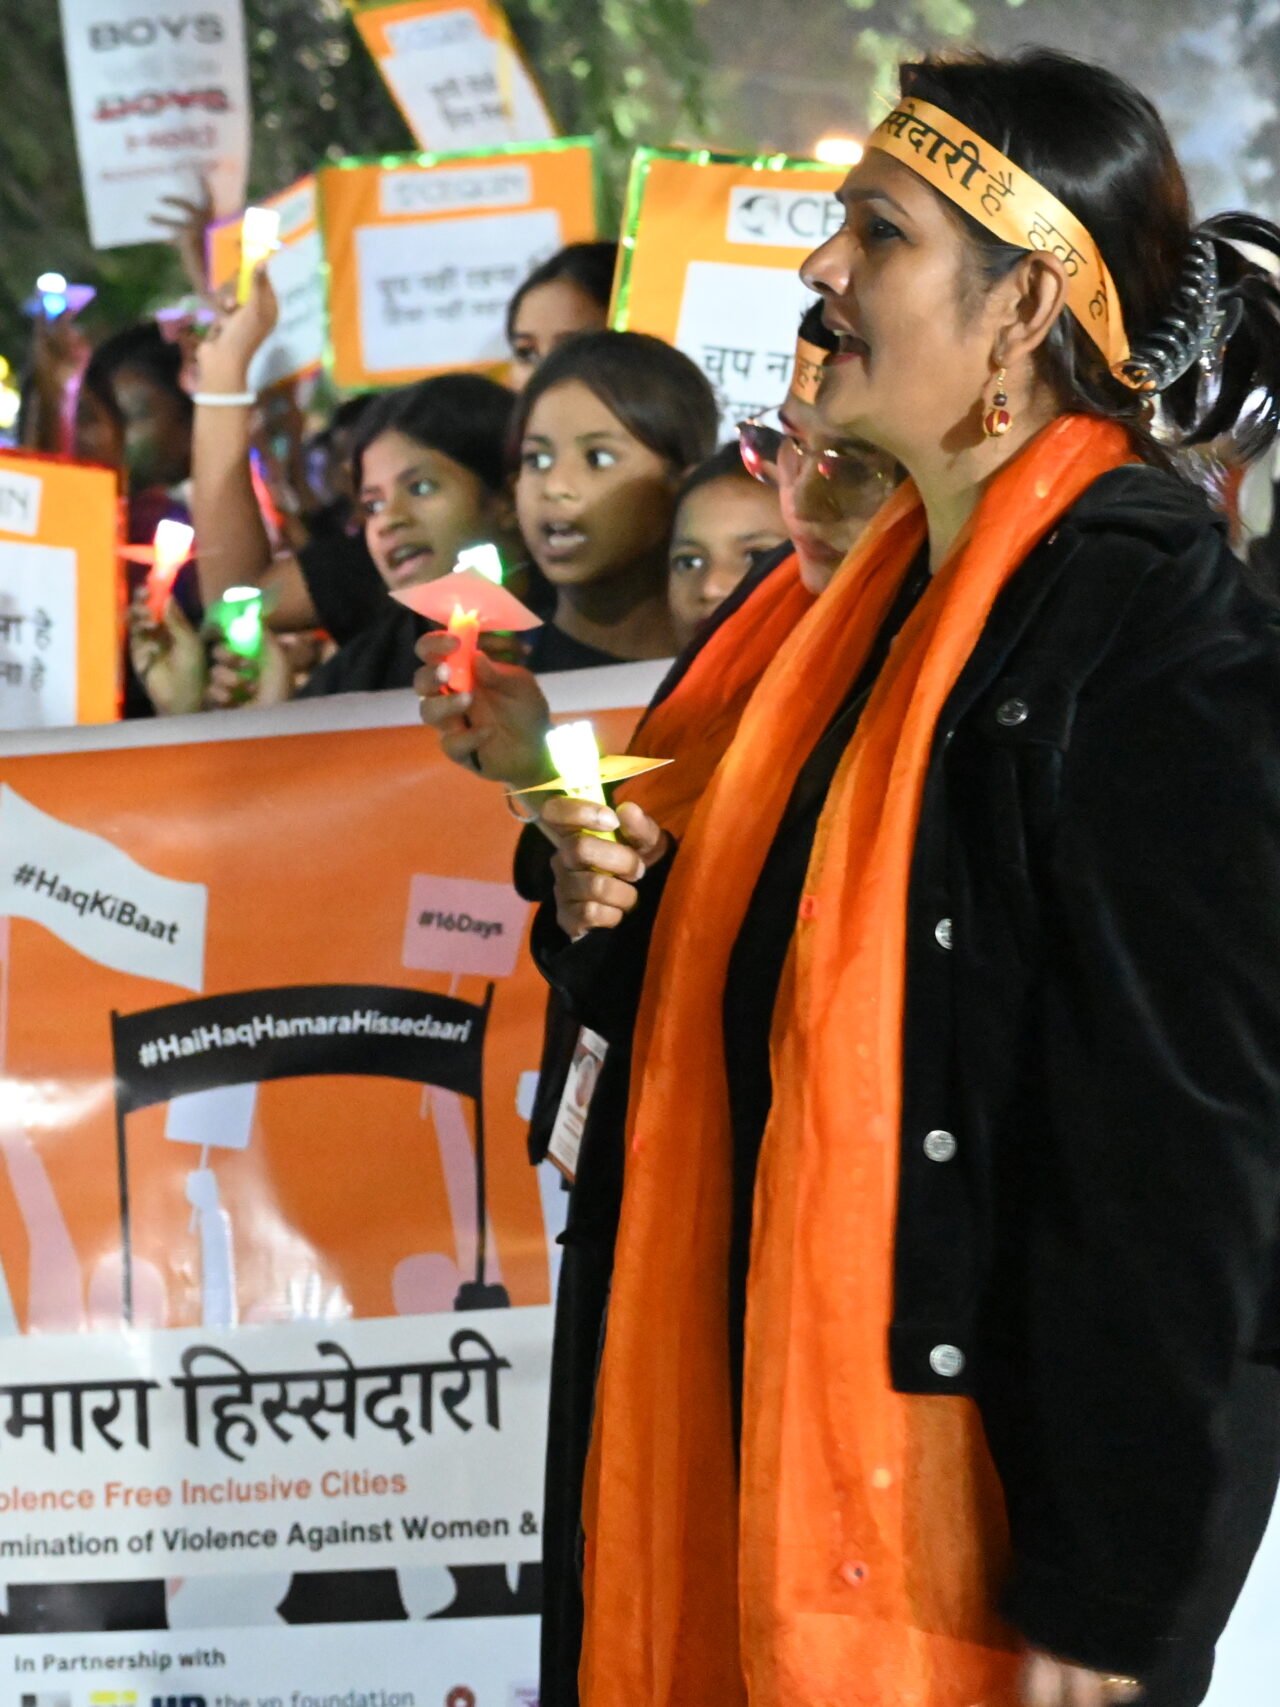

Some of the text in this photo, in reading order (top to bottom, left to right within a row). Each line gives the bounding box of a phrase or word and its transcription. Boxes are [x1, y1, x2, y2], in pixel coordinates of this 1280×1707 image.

[88, 12, 224, 51] BOYS
[11, 861, 180, 945] #HaqKiBaat
[417, 908, 504, 939] #16Days
[137, 1009, 473, 1069] #HaiHaqHamaraHissedaari
[171, 1327, 513, 1463] हिस्सेदारी
[103, 1481, 172, 1508] Free
[181, 1475, 312, 1505] Inclusive
[320, 1469, 408, 1497] Cities
[128, 1530, 154, 1554] of
[163, 1525, 278, 1553] Violence
[286, 1517, 393, 1551] Against
[401, 1514, 510, 1541] Women
[519, 1511, 539, 1535] &
[14, 1648, 227, 1674] In Partnership with
